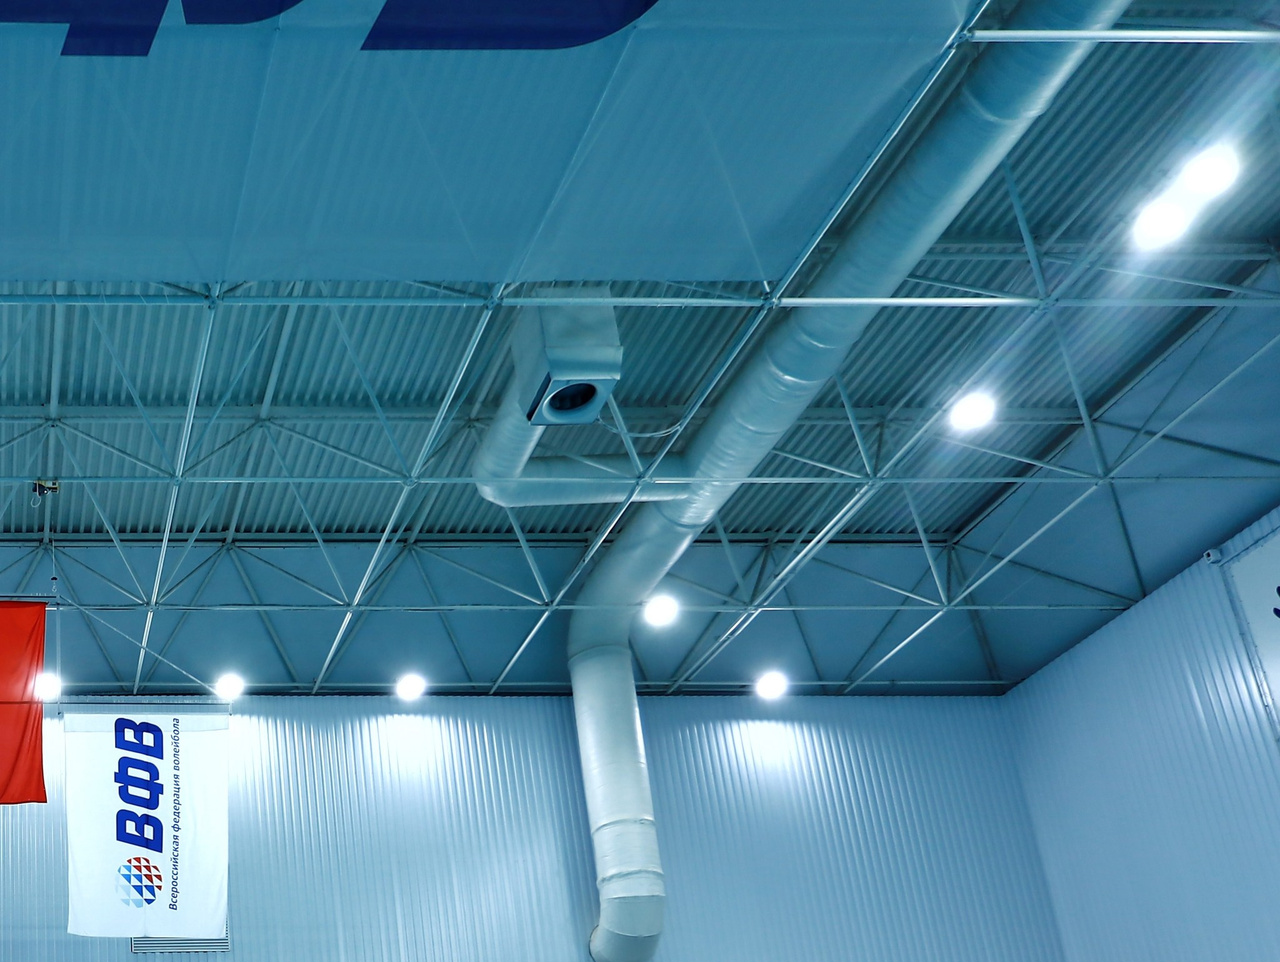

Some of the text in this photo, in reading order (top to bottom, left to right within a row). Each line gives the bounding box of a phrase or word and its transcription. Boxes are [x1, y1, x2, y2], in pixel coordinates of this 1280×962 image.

[114, 717, 164, 853] ВФВ
[168, 718, 183, 911] Всероссийская федерация волейбола
